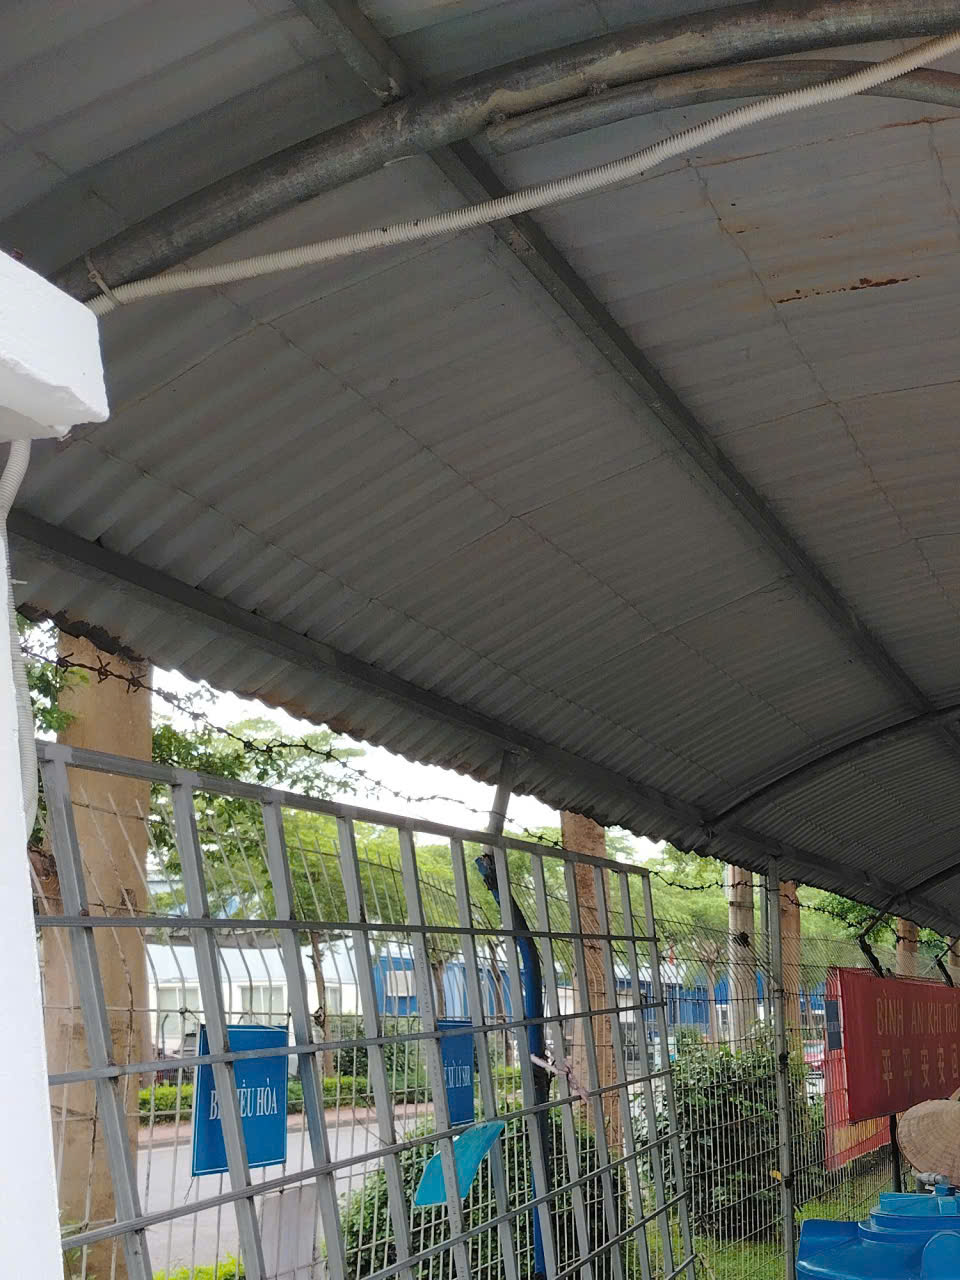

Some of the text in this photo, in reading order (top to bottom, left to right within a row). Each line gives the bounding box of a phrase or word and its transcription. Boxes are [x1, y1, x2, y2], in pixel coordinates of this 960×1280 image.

[876, 989, 904, 1038] BÌNH
[911, 1001, 924, 1034] AN
[928, 1001, 943, 1036] KHI
